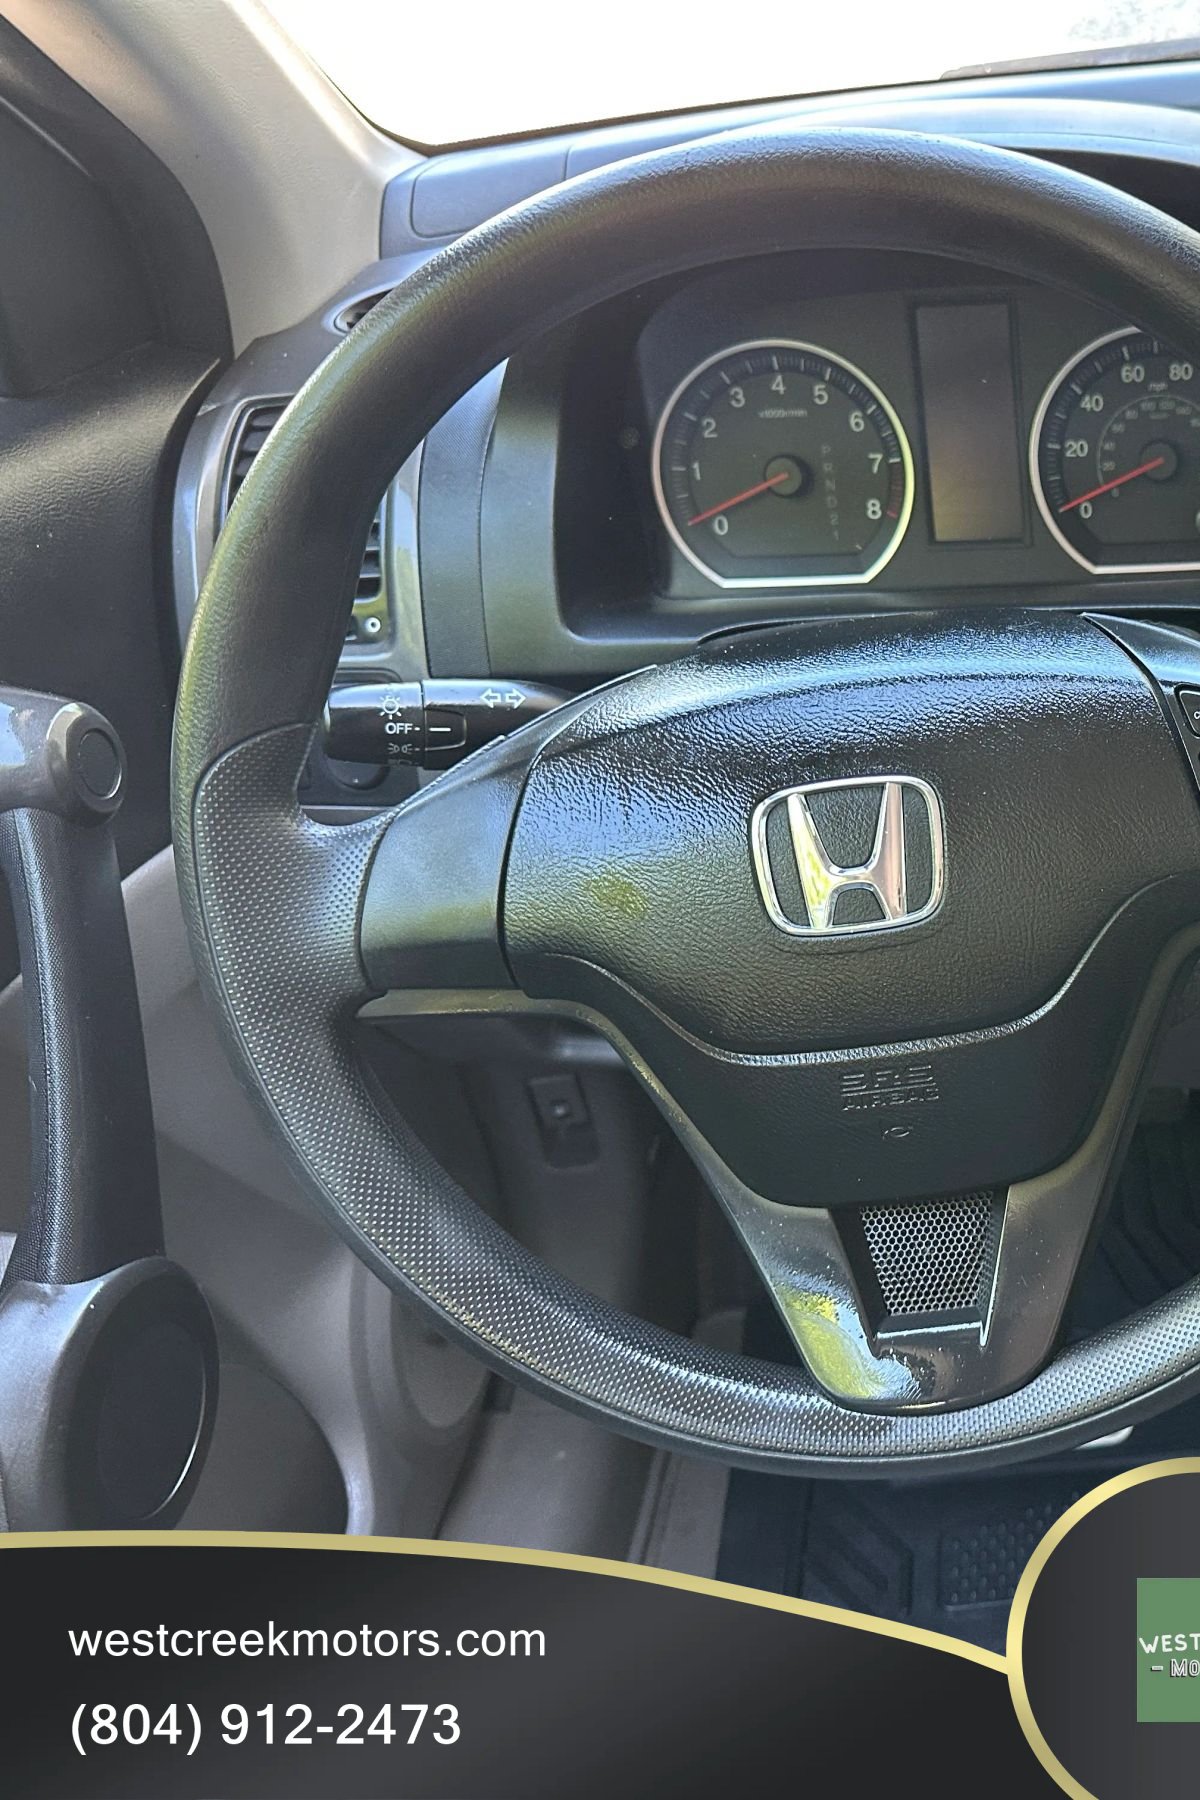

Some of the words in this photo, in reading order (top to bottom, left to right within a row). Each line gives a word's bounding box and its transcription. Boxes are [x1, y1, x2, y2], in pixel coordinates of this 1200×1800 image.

[1121, 365, 1145, 383] 60
[1169, 362, 1194, 381] 80
[771, 375, 787, 395] 4
[813, 384, 829, 405] 5
[729, 387, 746, 408] 3
[1080, 395, 1104, 412] 40
[702, 418, 718, 438] 2
[850, 411, 865, 432] 6
[1064, 441, 1089, 458] 20
[692, 462, 701, 480] 1
[868, 453, 883, 474] 7
[866, 499, 882, 520] 8
[1079, 502, 1093, 519] 0
[713, 515, 729, 536] 0
